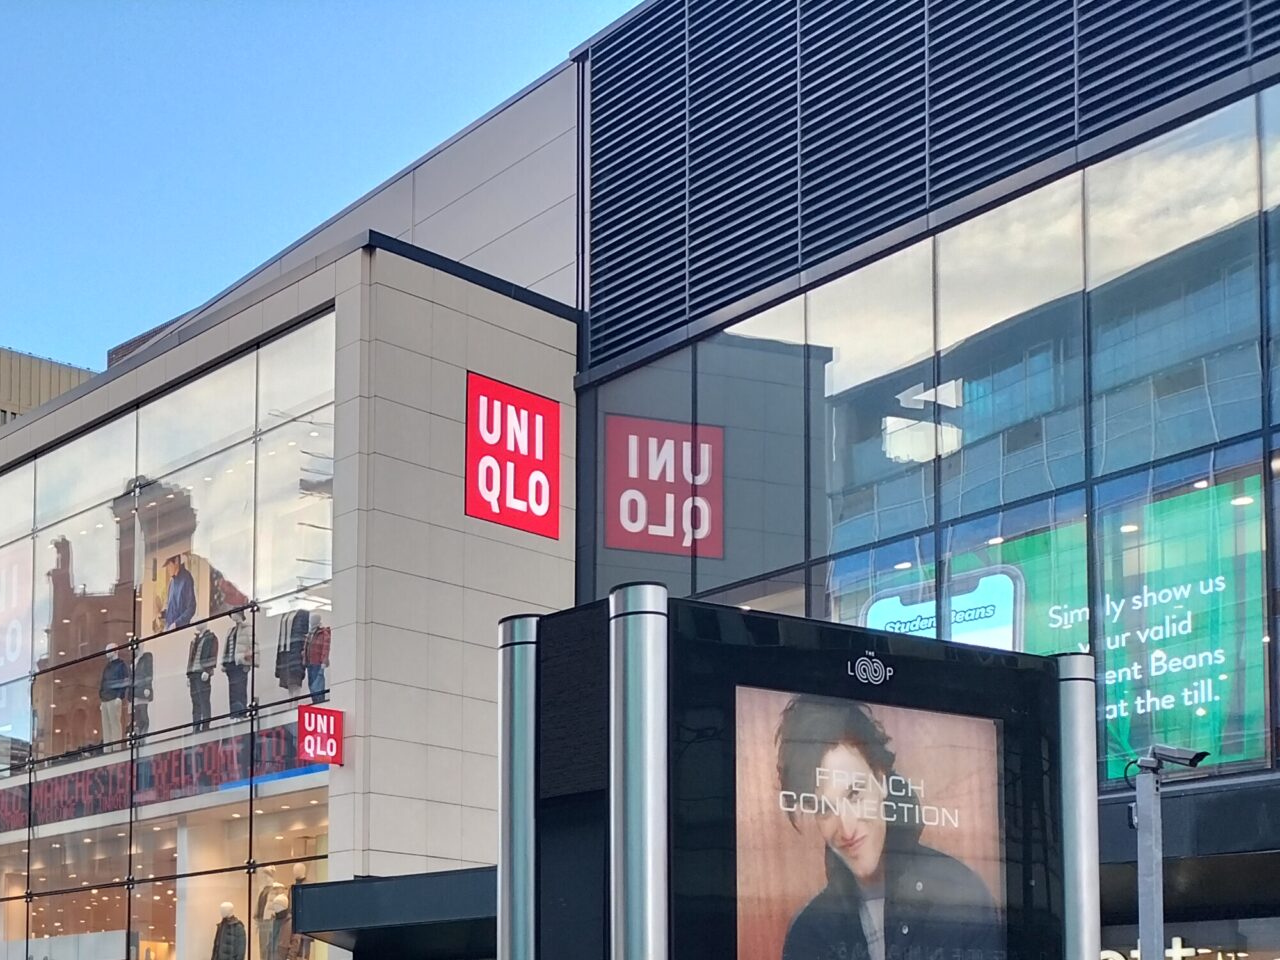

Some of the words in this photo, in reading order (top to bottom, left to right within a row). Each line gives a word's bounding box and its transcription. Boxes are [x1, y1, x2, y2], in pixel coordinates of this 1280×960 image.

[478, 395, 544, 461] UNI
[478, 455, 550, 517] QLO
[1048, 594, 1125, 628] Simly
[1131, 585, 1192, 610] show
[1199, 575, 1226, 595] us
[885, 615, 937, 633] Studen
[1136, 610, 1192, 643] valid
[1150, 649, 1225, 677] Beans
[1106, 698, 1129, 719] at
[1134, 690, 1175, 715] the
[1181, 679, 1220, 706] till.
[304, 712, 334, 734] UNI
[304, 735, 337, 757] QLO
[32, 760, 136, 811] MANCHESTER
[815, 767, 925, 798] FRENCH
[779, 790, 959, 828] CONNECTION
